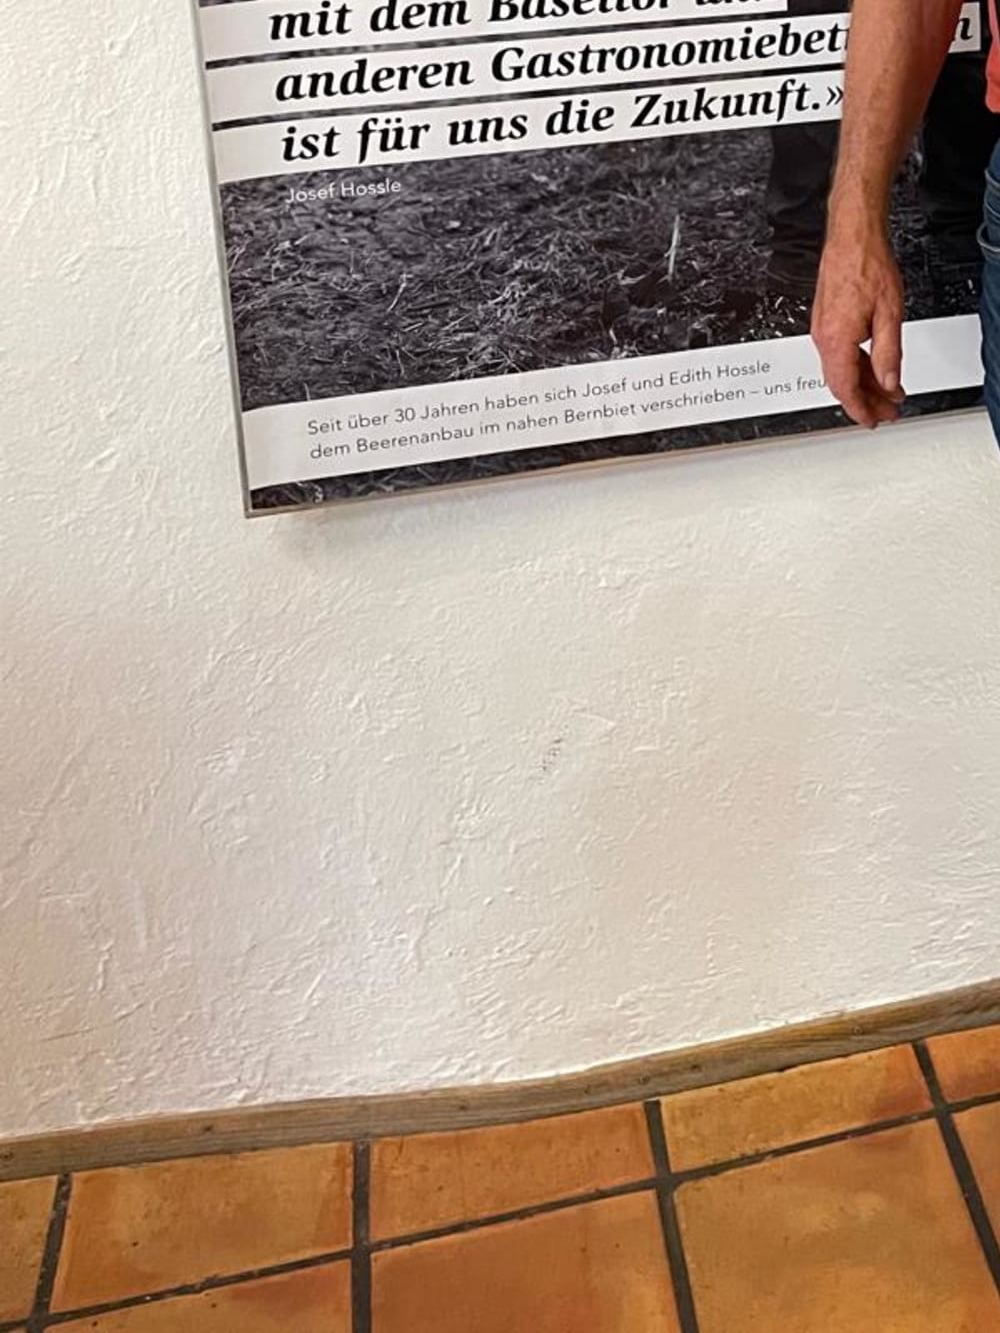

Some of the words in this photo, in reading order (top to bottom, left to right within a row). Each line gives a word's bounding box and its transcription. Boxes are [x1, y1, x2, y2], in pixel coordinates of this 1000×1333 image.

[269, 0, 353, 40] mit
[276, 58, 474, 102] anderen
[282, 126, 341, 162] ist
[357, 117, 431, 164] für
[447, 113, 528, 146] uns
[546, 99, 615, 136] die
[630, 79, 844, 128] Zukunft.»
[285, 183, 337, 204] Josef
[341, 177, 401, 197] Hossle
[307, 419, 343, 436] Seit
[348, 413, 389, 430] über
[394, 407, 416, 423] 30
[420, 402, 480, 420] Jahren
[485, 394, 539, 411] haben
[544, 386, 577, 403] sich
[582, 378, 627, 398] Josef
[631, 374, 665, 391] und
[669, 368, 712, 386] Edith
[717, 360, 771, 378] Hossle
[310, 444, 350, 459] dem
[356, 427, 474, 453] Beerenanbau
[479, 422, 501, 435] im
[505, 414, 559, 432] nahen
[564, 403, 636, 424] Bernbiet
[640, 388, 746, 413] verschrieben
[764, 383, 792, 397] uns
[796, 376, 827, 392] freu
